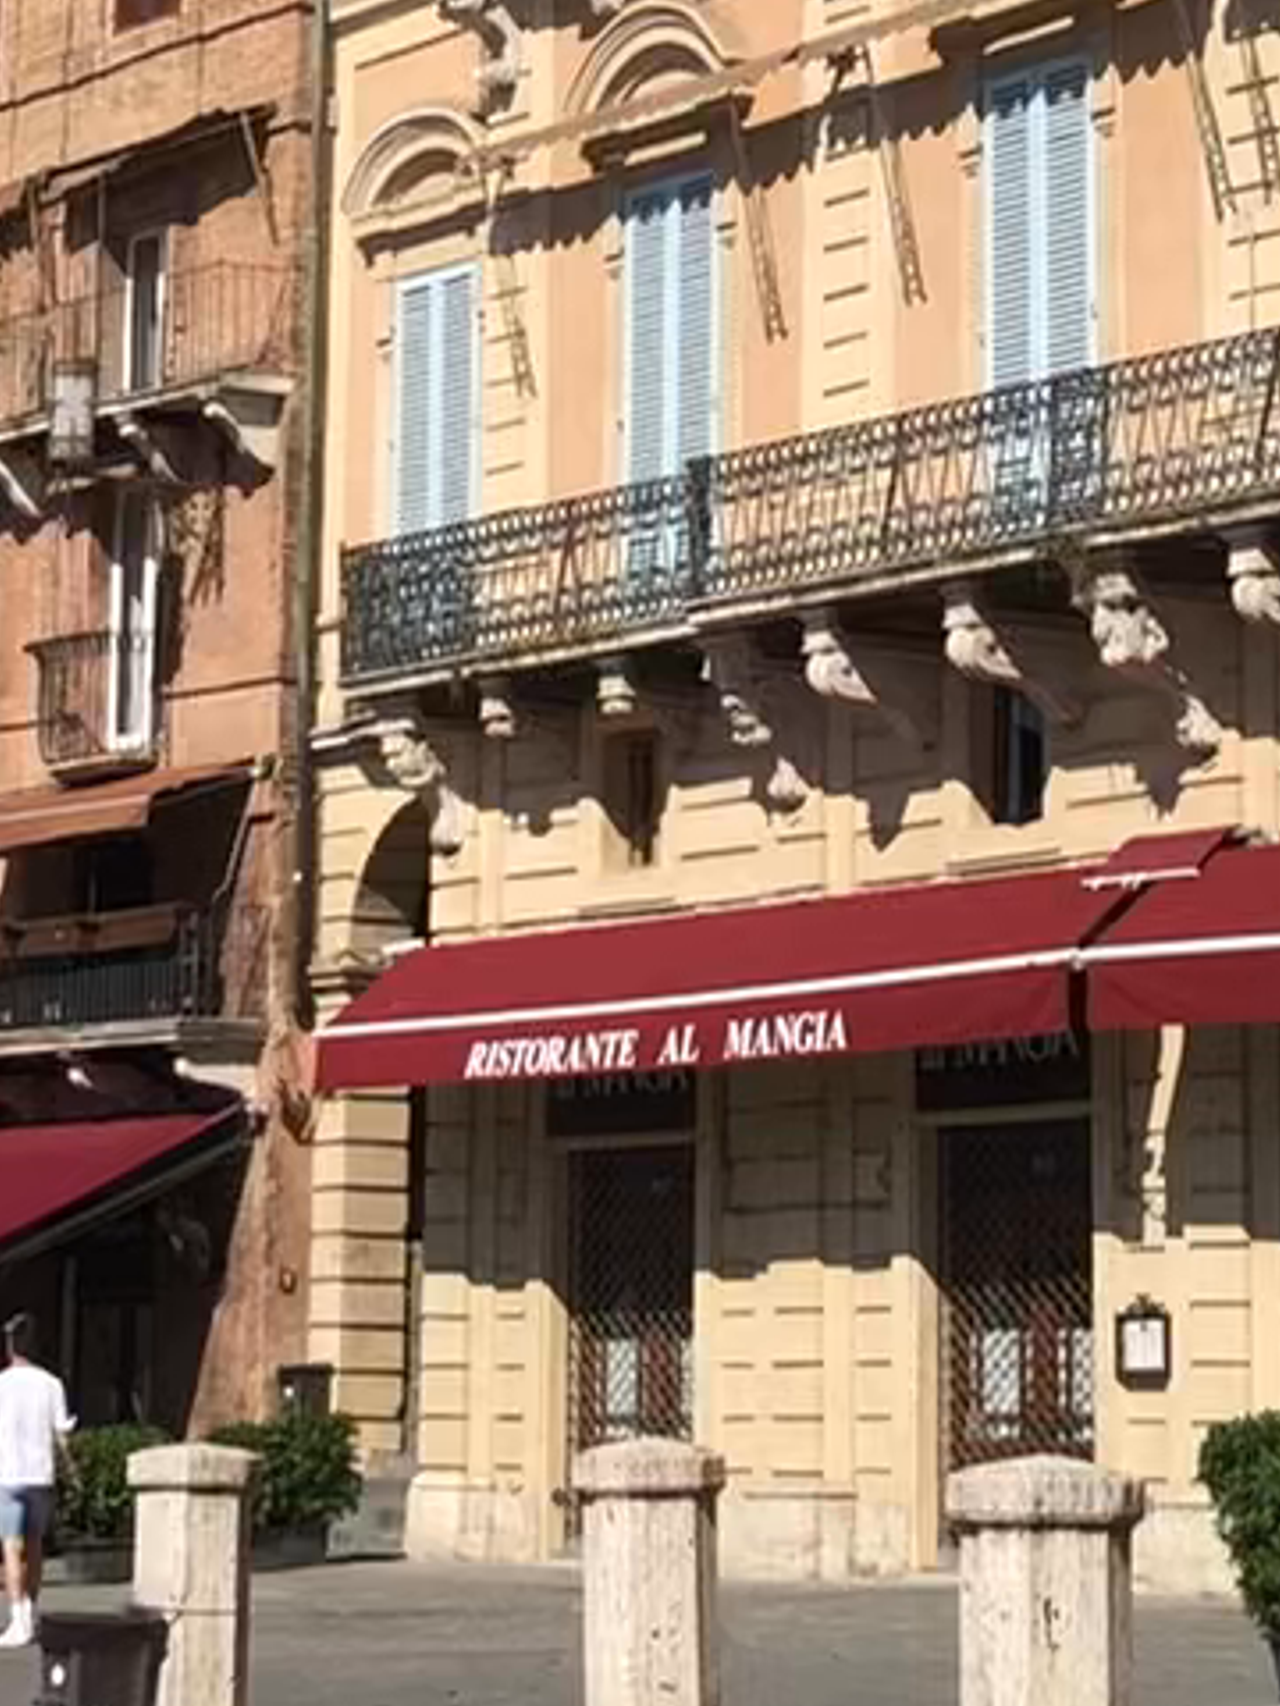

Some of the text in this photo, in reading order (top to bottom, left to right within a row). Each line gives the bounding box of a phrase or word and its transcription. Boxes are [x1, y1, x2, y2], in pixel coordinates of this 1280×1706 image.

[463, 1010, 847, 1079] RISTORANTE AL MANGIA
